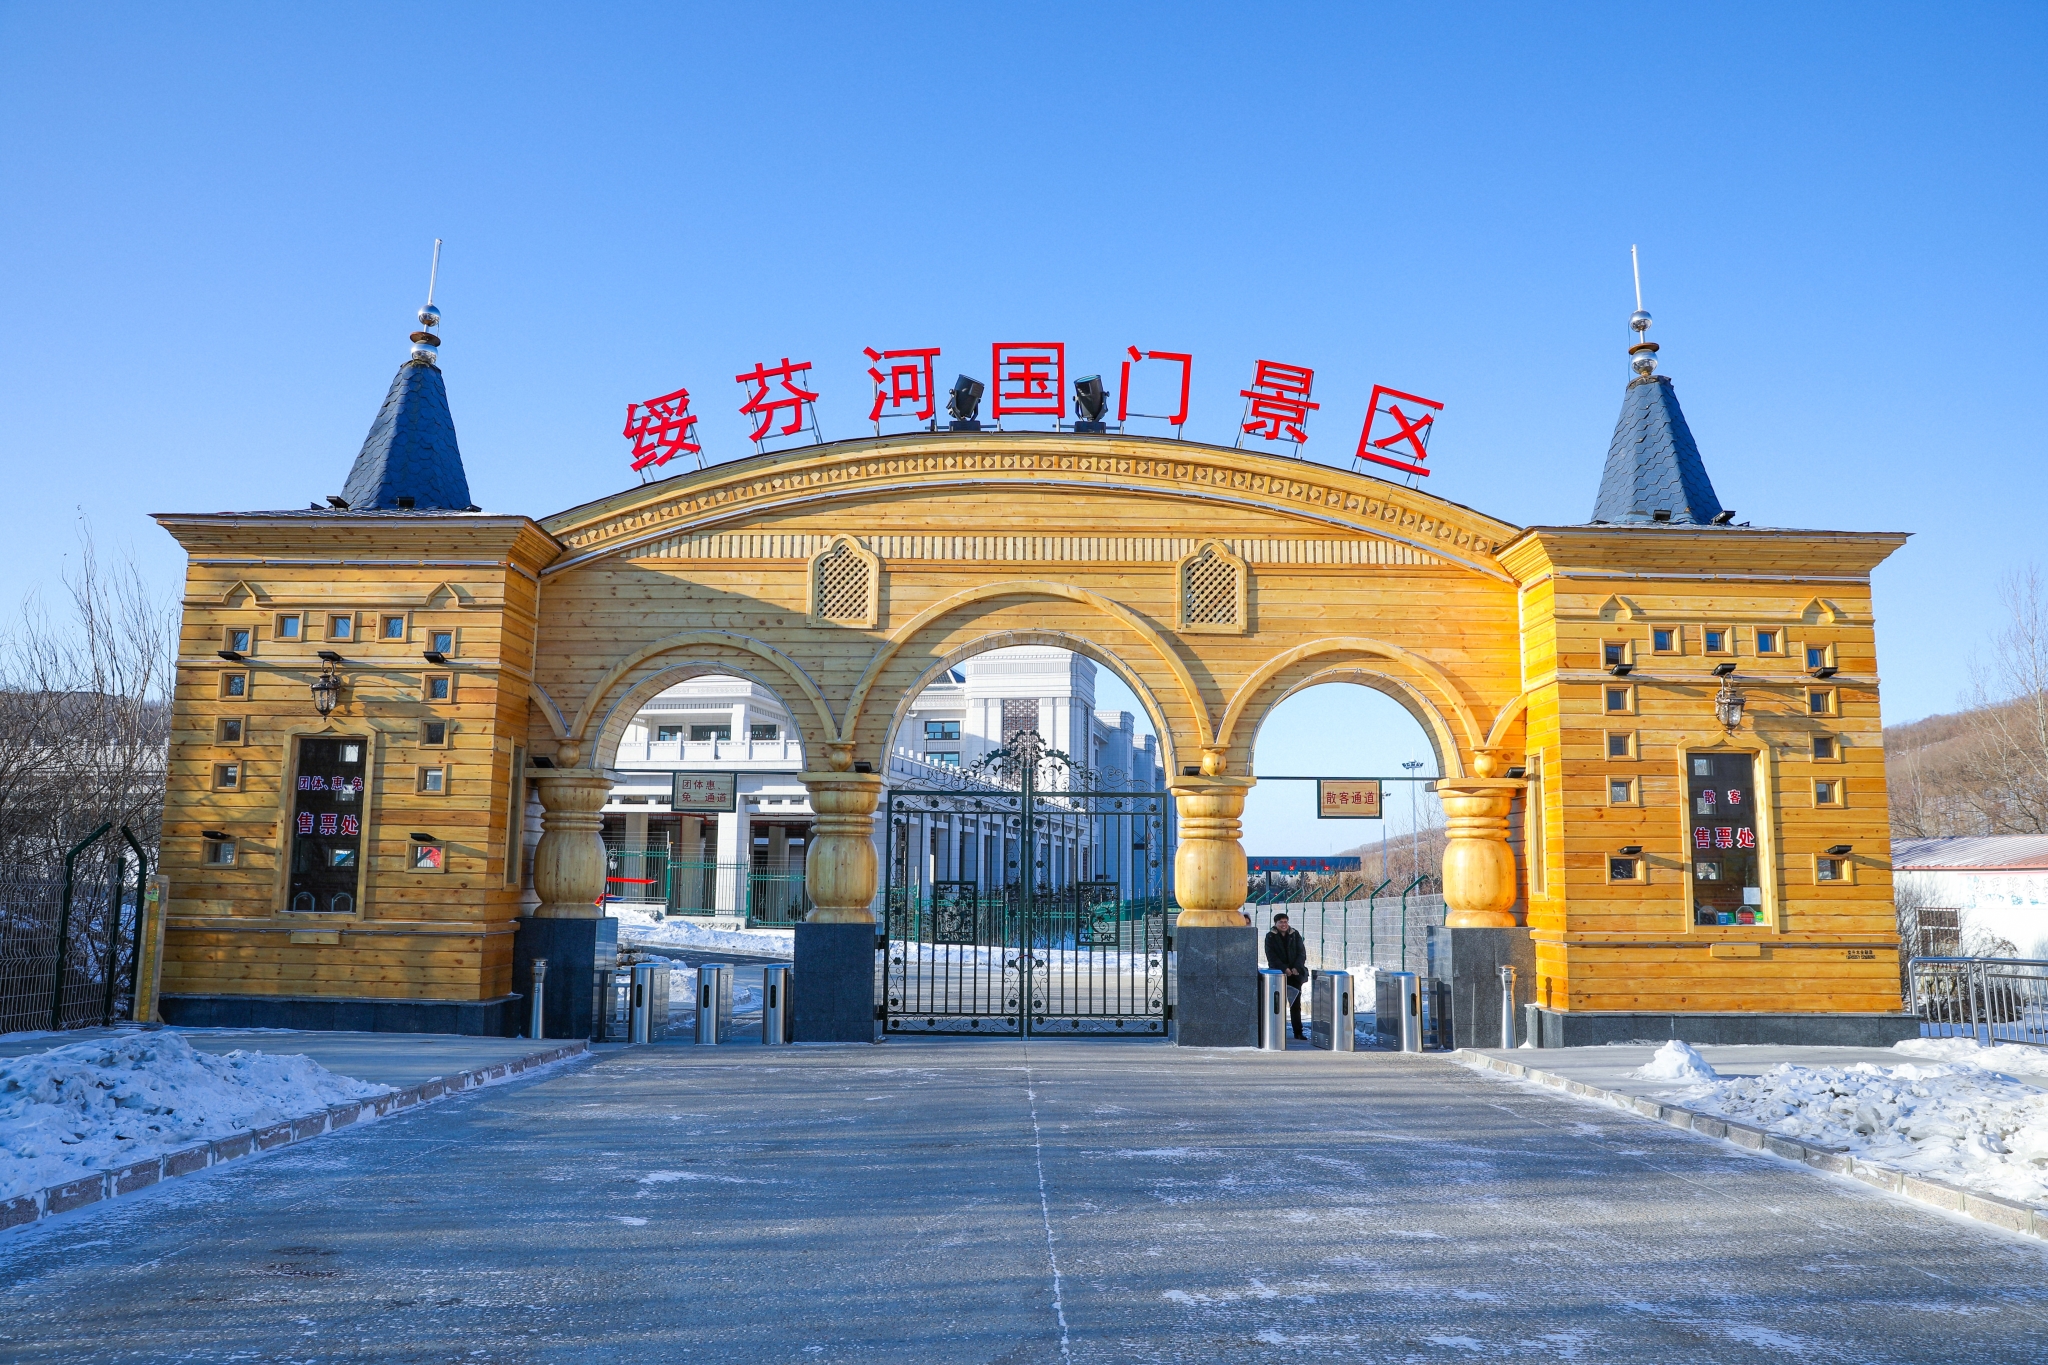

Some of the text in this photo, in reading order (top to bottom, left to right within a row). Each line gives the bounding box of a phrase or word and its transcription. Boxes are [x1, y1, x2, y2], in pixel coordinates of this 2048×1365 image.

[623, 343, 1444, 475] 绥芬河国门景区
[1326, 791, 1375, 805] 散客通道
[1703, 790, 1741, 804] 散客
[297, 812, 359, 835] 售票处
[1694, 827, 1755, 848] 售票处
